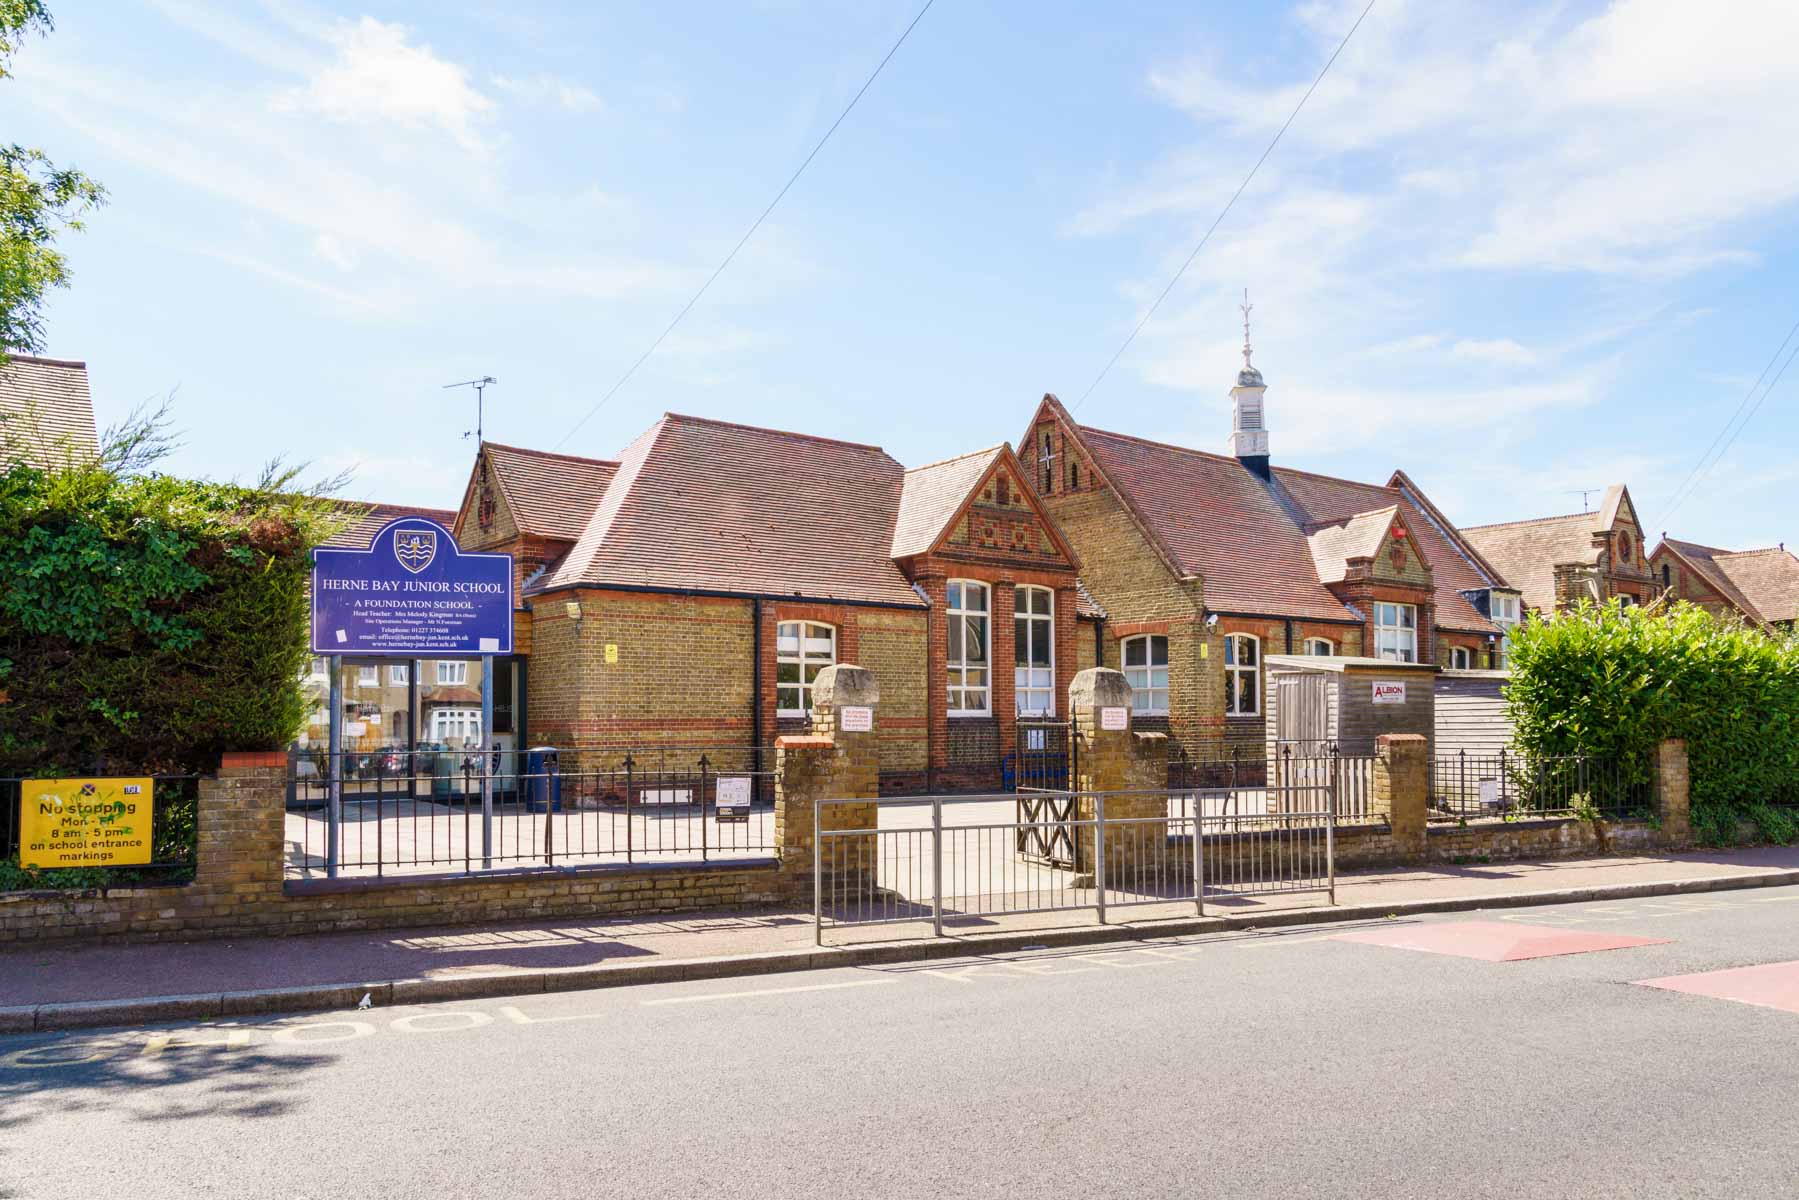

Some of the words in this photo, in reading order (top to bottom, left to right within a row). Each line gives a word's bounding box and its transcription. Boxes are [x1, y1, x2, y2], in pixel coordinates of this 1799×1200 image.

[323, 579, 369, 591] HERNE
[371, 580, 401, 591] BAY
[403, 580, 452, 592] JUNIOR
[453, 582, 505, 594] SCHOOL
[354, 599, 362, 608] A
[364, 600, 432, 609] FOUNDATION
[433, 600, 475, 609] SCHOOL
[1375, 686, 1403, 698] ALBION
[40, 803, 64, 814] No
[61, 817, 89, 826] Mon
[51, 829, 59, 838] 8
[64, 830, 81, 838] am
[94, 828, 101, 837] 5
[105, 829, 123, 838] pm
[48, 840, 88, 850] school
[92, 840, 142, 848] entrance
[60, 851, 114, 861] markings
[0, 1003, 608, 1069] CHOOL
